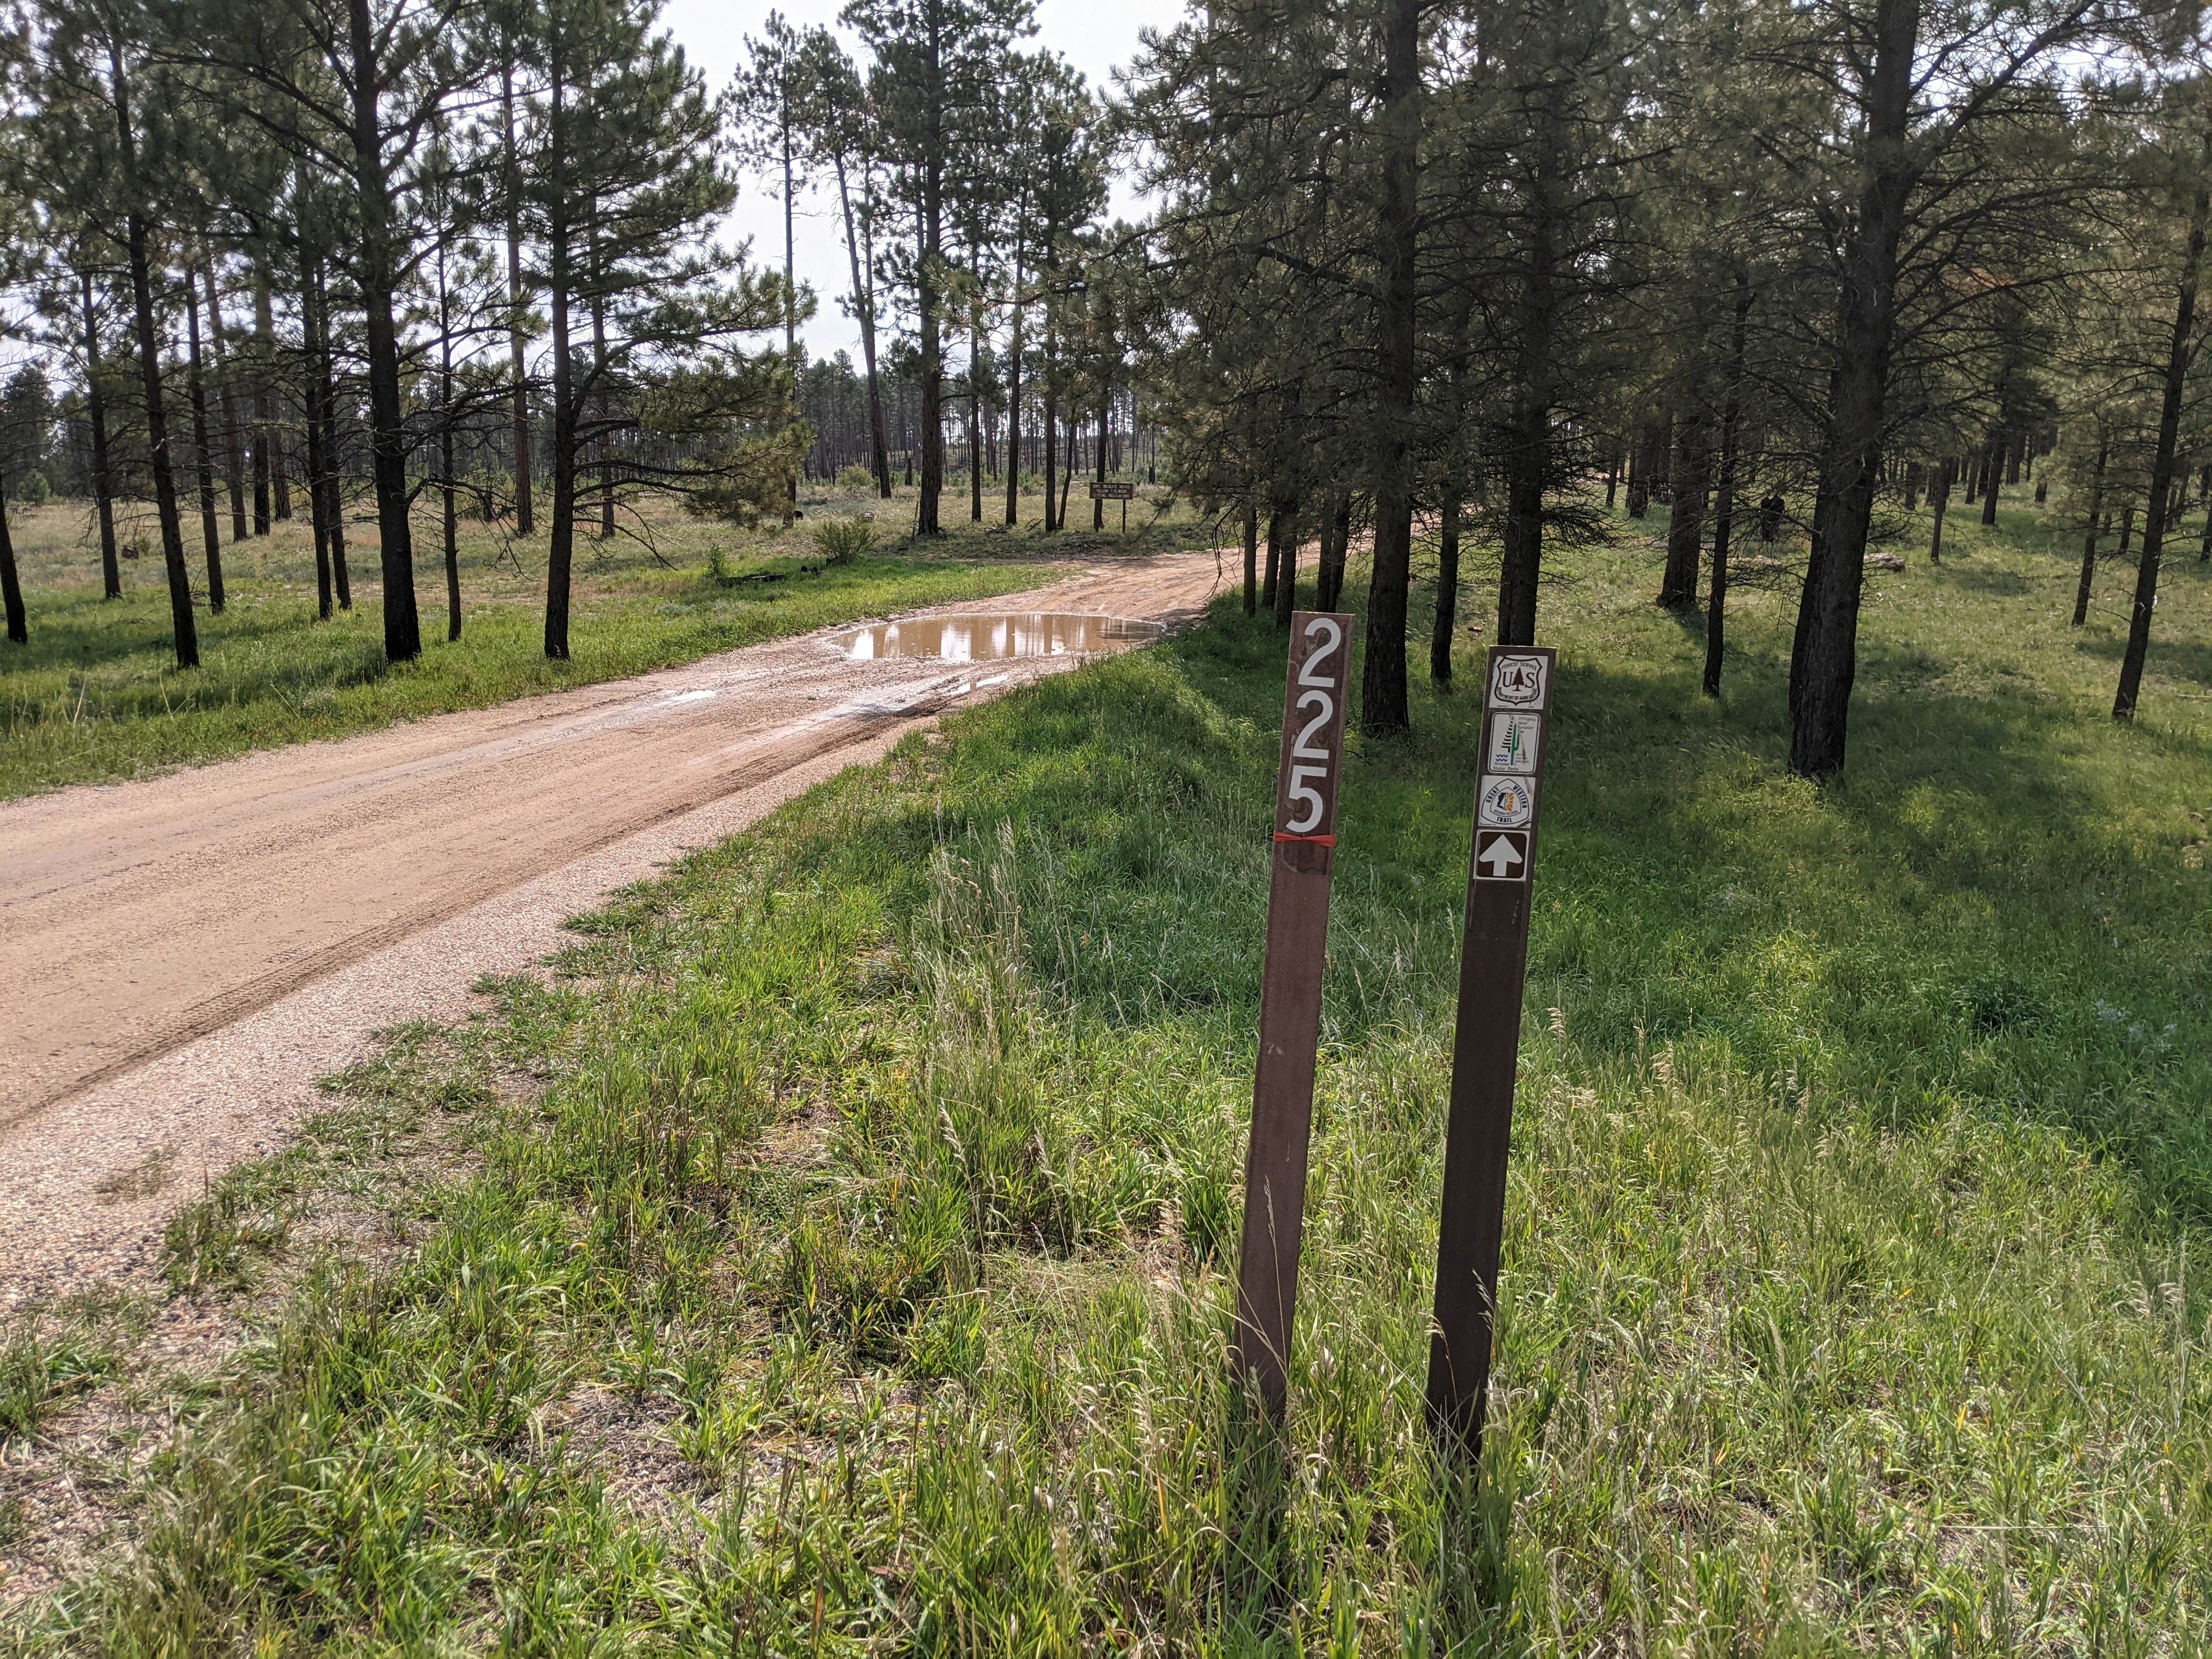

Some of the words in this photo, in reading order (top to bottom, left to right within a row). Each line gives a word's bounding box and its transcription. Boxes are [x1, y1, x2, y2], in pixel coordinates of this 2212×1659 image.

[1502, 662, 1519, 670] FOREST
[1520, 662, 1537, 671] SERVICE
[1286, 618, 1341, 833] 225
[1486, 787, 1499, 803] GREAT
[1513, 785, 1527, 809] WESTERN
